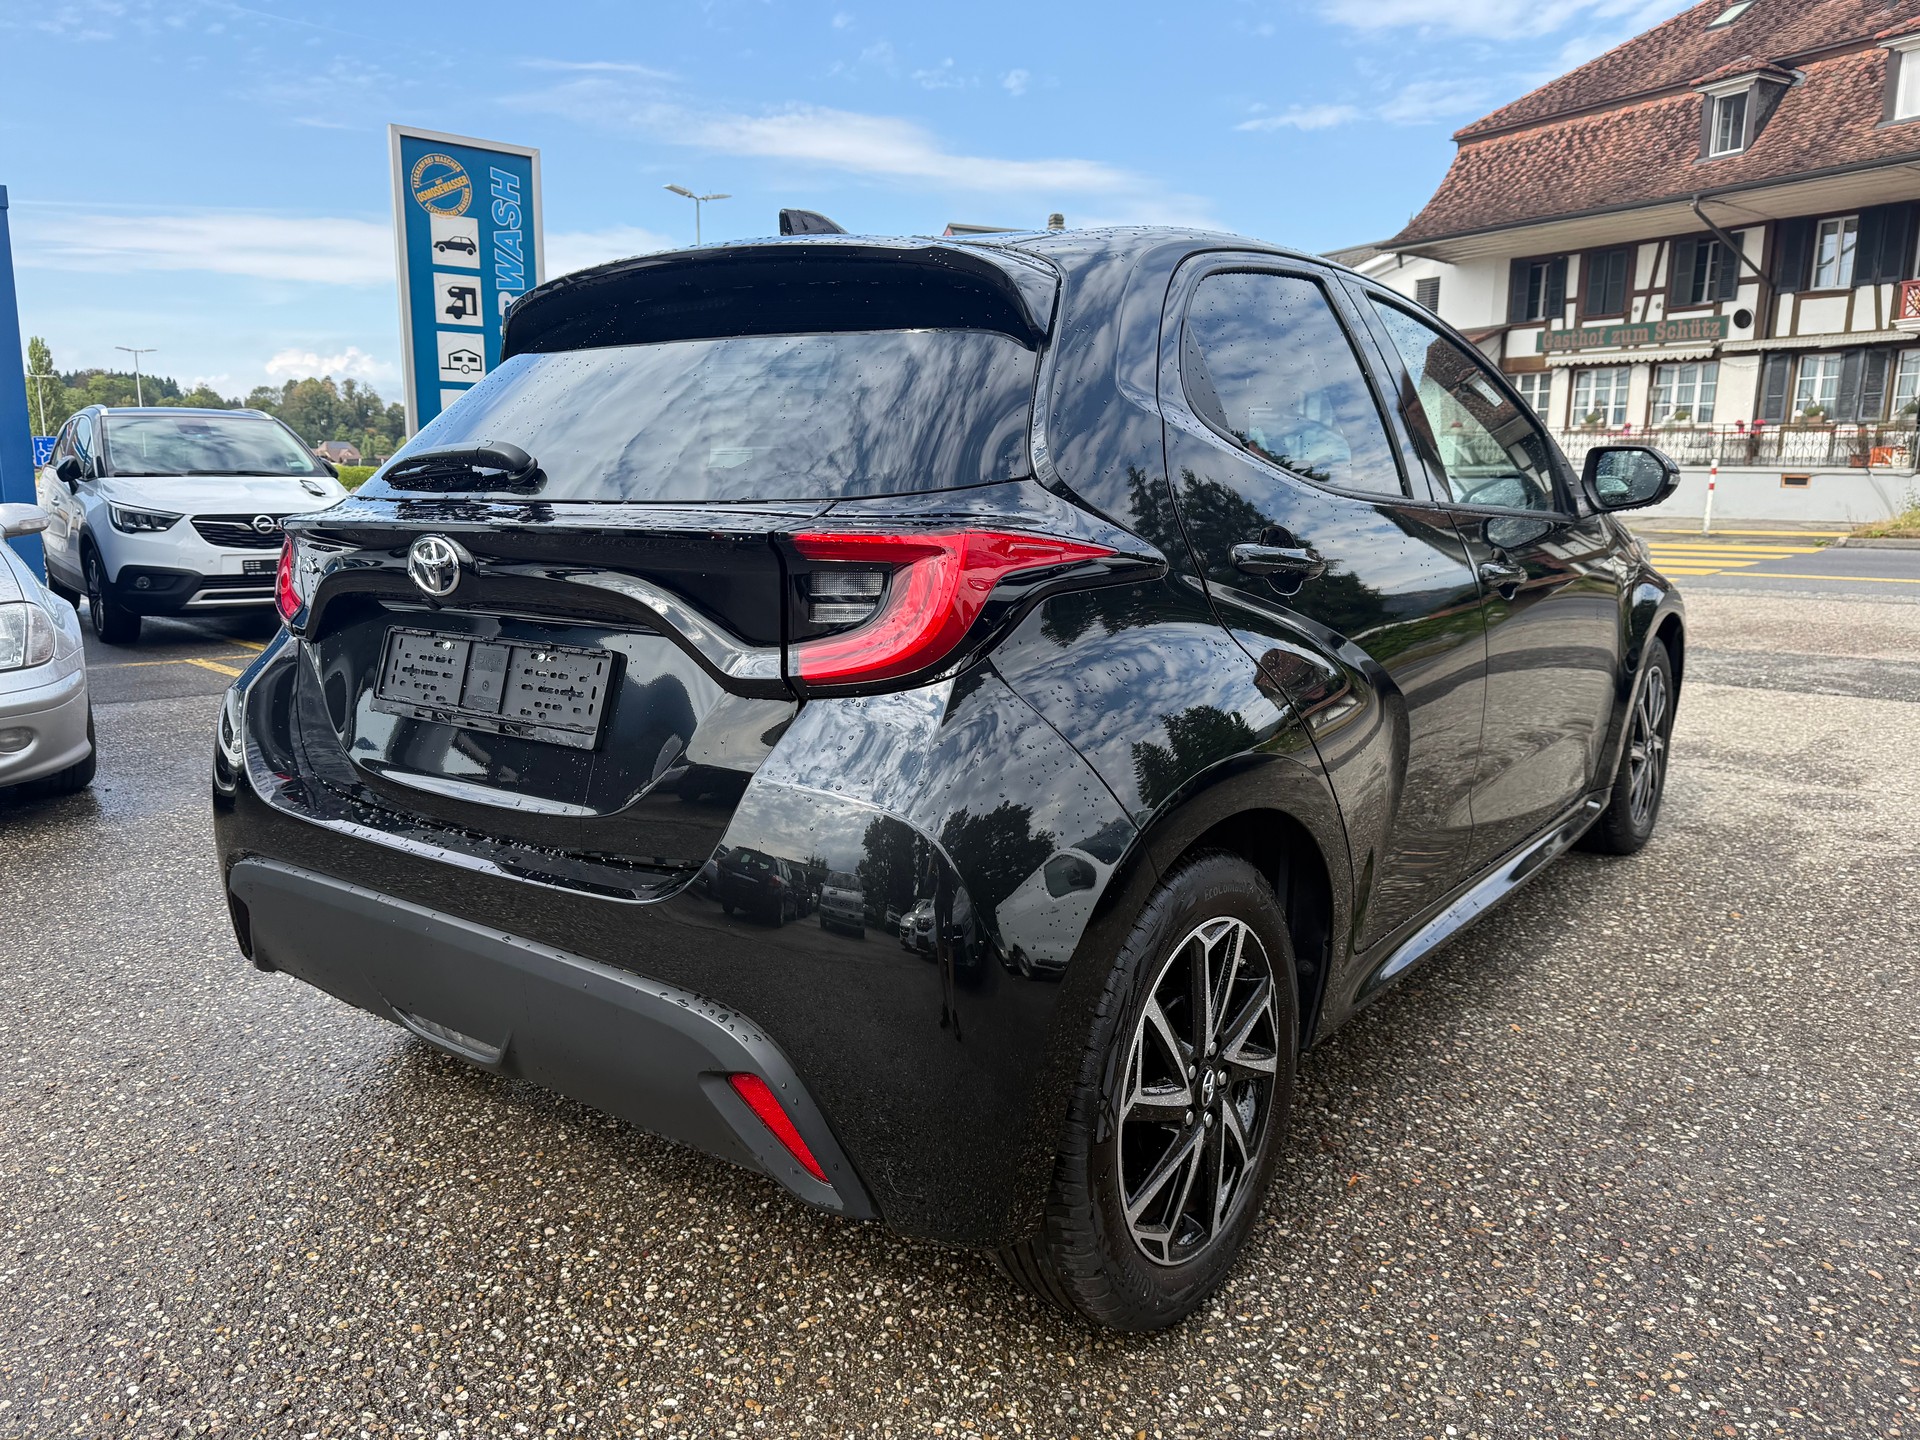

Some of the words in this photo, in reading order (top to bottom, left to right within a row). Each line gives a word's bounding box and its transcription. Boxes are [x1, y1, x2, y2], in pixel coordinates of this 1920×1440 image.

[417, 175, 469, 202] OSMOSEWASSER
[1542, 327, 1607, 350] Gasthof
[1611, 326, 1649, 344] zum
[1654, 319, 1720, 341] Schütz
